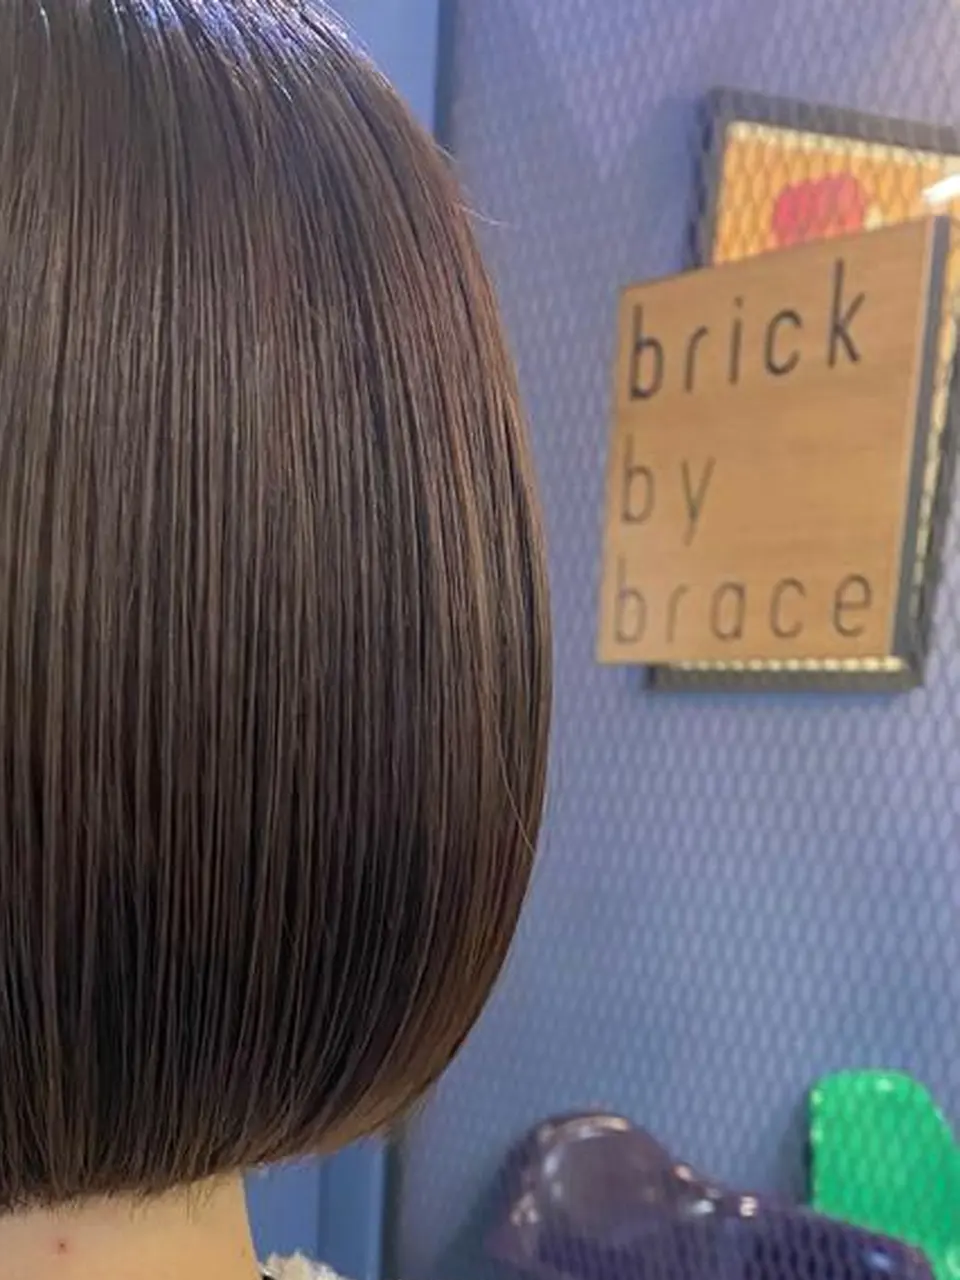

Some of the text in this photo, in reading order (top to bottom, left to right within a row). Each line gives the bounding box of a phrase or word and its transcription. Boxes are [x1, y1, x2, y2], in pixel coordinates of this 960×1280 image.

[630, 258, 865, 401] brick
[621, 434, 715, 548] by
[615, 555, 873, 646] brace
